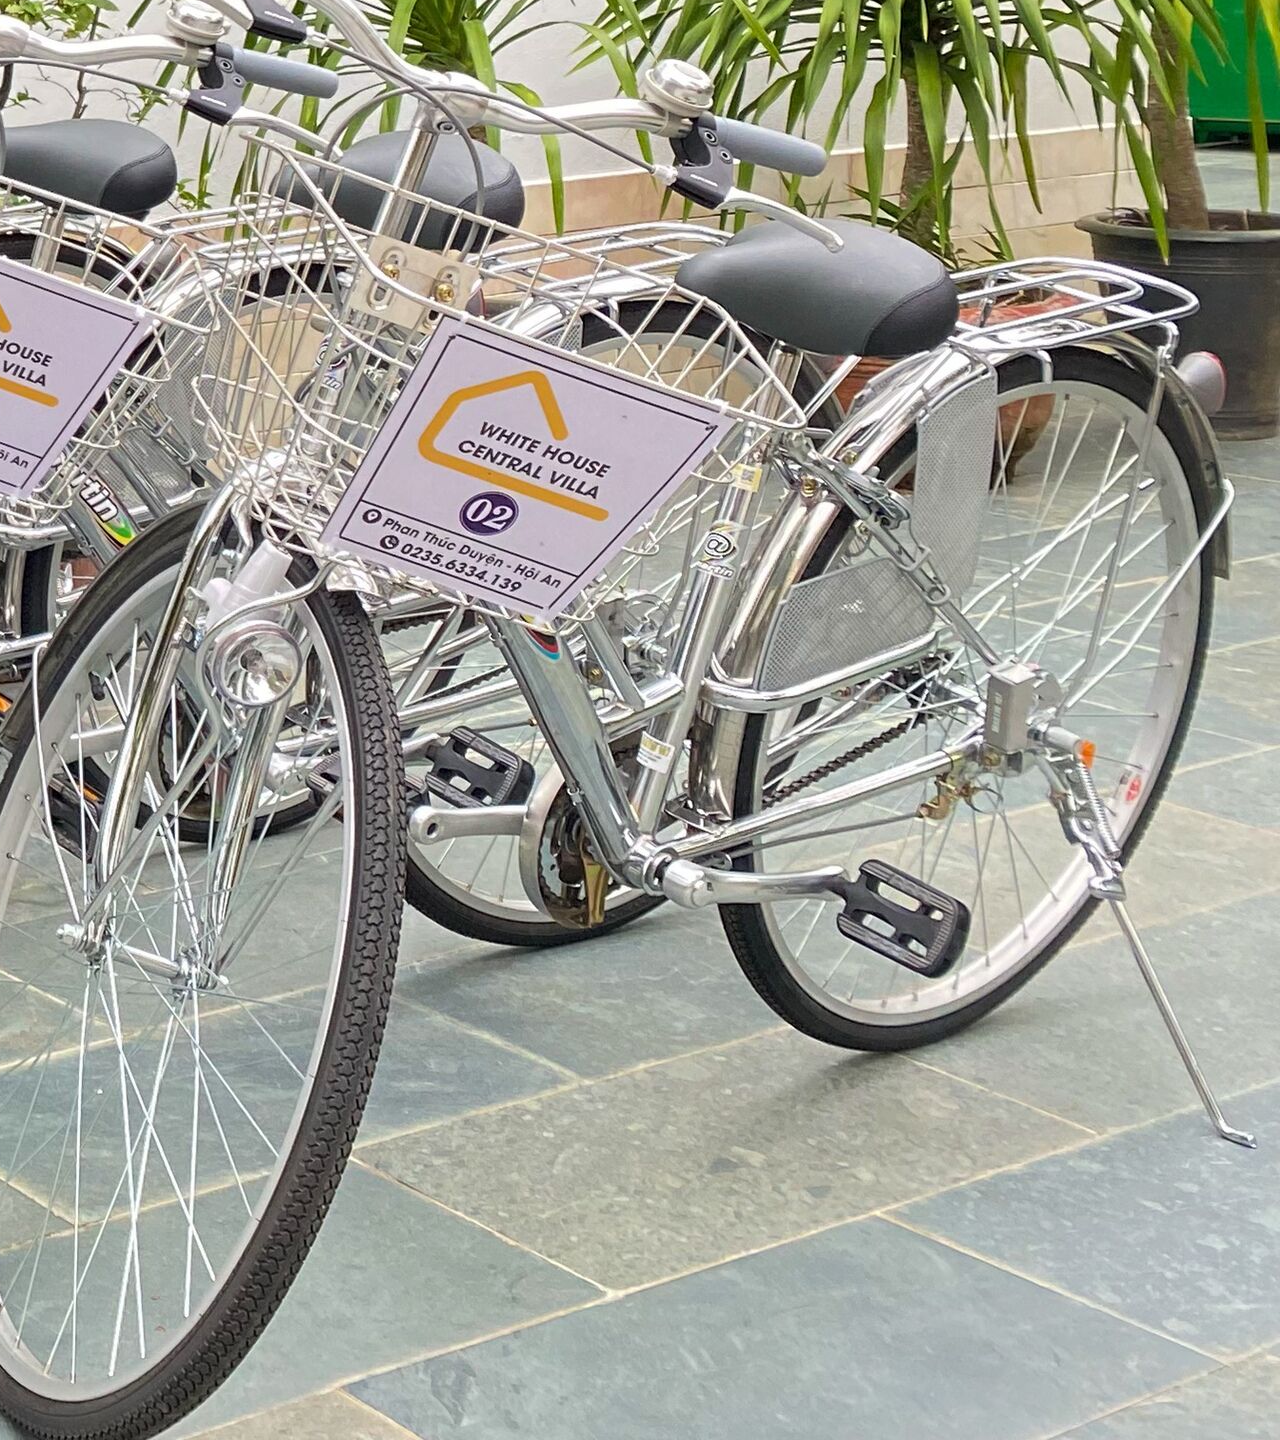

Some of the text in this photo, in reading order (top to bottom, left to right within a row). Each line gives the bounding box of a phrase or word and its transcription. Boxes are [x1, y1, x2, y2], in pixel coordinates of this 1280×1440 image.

[1, 360, 47, 387] VILLA
[10, 455, 29, 469] An
[457, 439, 599, 500] CENTRAL VILLA
[479, 421, 612, 479] WHITE HOUSE
[465, 498, 515, 530] 02
[382, 517, 420, 539] Phan
[423, 531, 457, 551] Thúc
[458, 545, 504, 568] Duyện
[513, 563, 538, 581] Hội
[540, 574, 562, 589] An
[400, 543, 522, 592] 0235.6334.139
